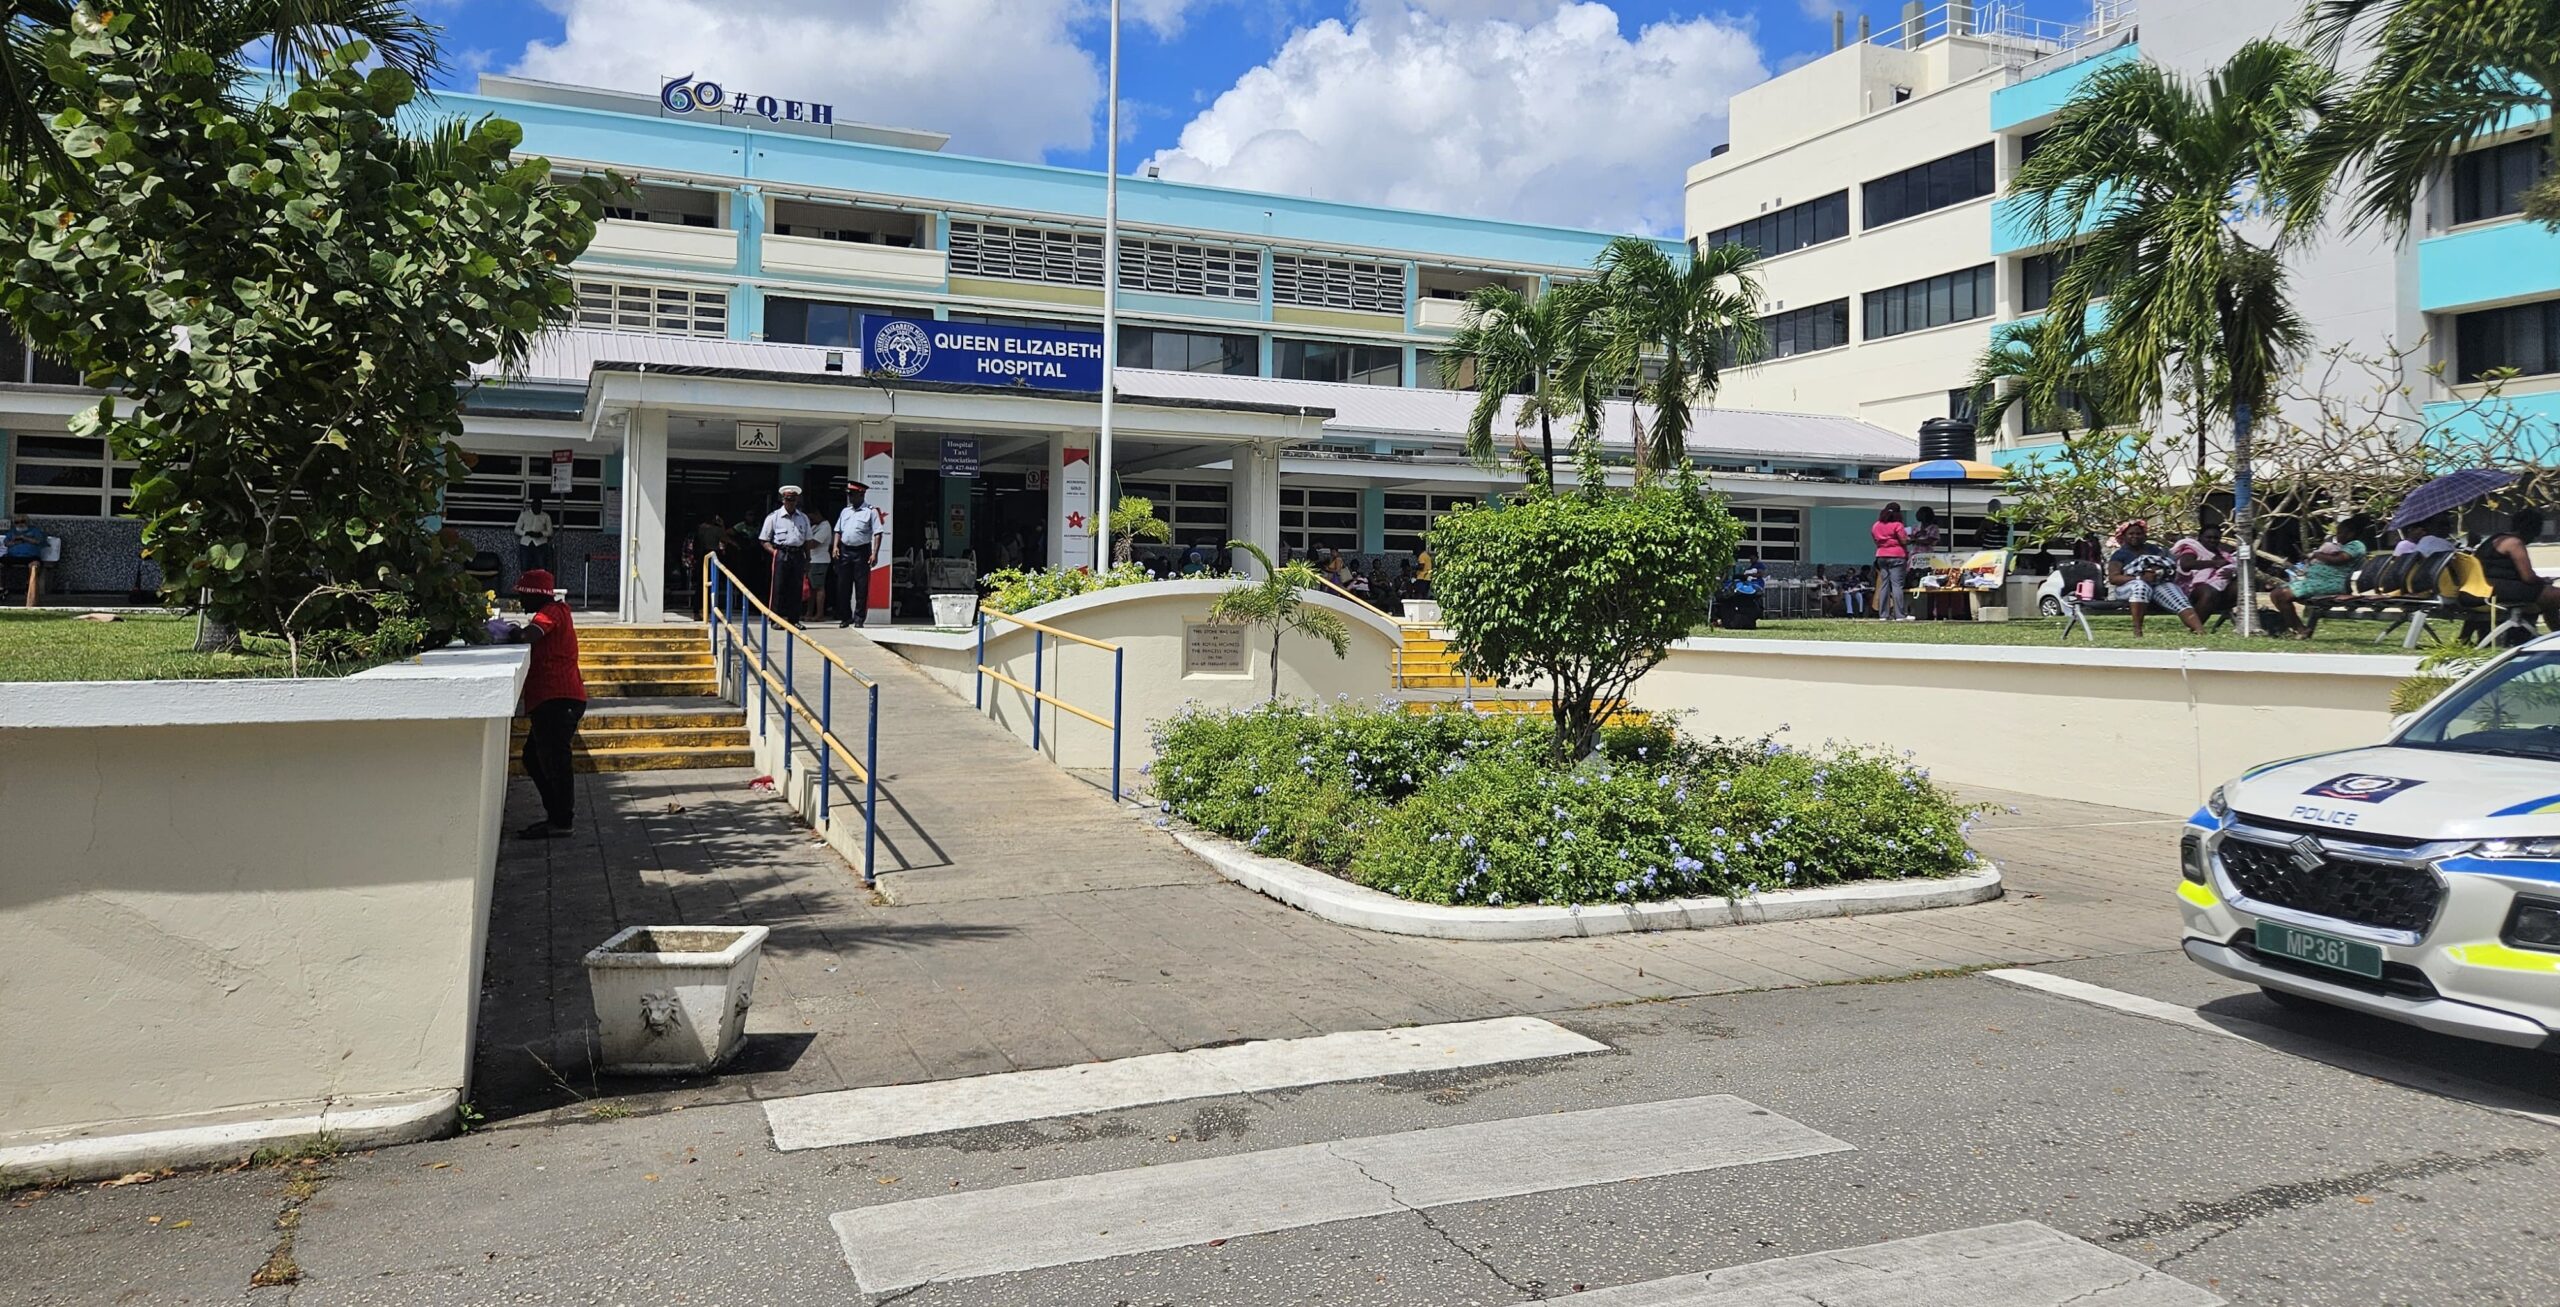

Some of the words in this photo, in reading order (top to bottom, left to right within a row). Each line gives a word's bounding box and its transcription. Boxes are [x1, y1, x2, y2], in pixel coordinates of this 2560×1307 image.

[934, 333, 999, 352] QUEEN
[1004, 338, 1102, 359] ELIZABETH
[977, 358, 1067, 378] HOSPITAL
[947, 441, 974, 449] Hospital
[2290, 805, 2359, 826] POLICE
[2286, 930, 2348, 967] MP361
